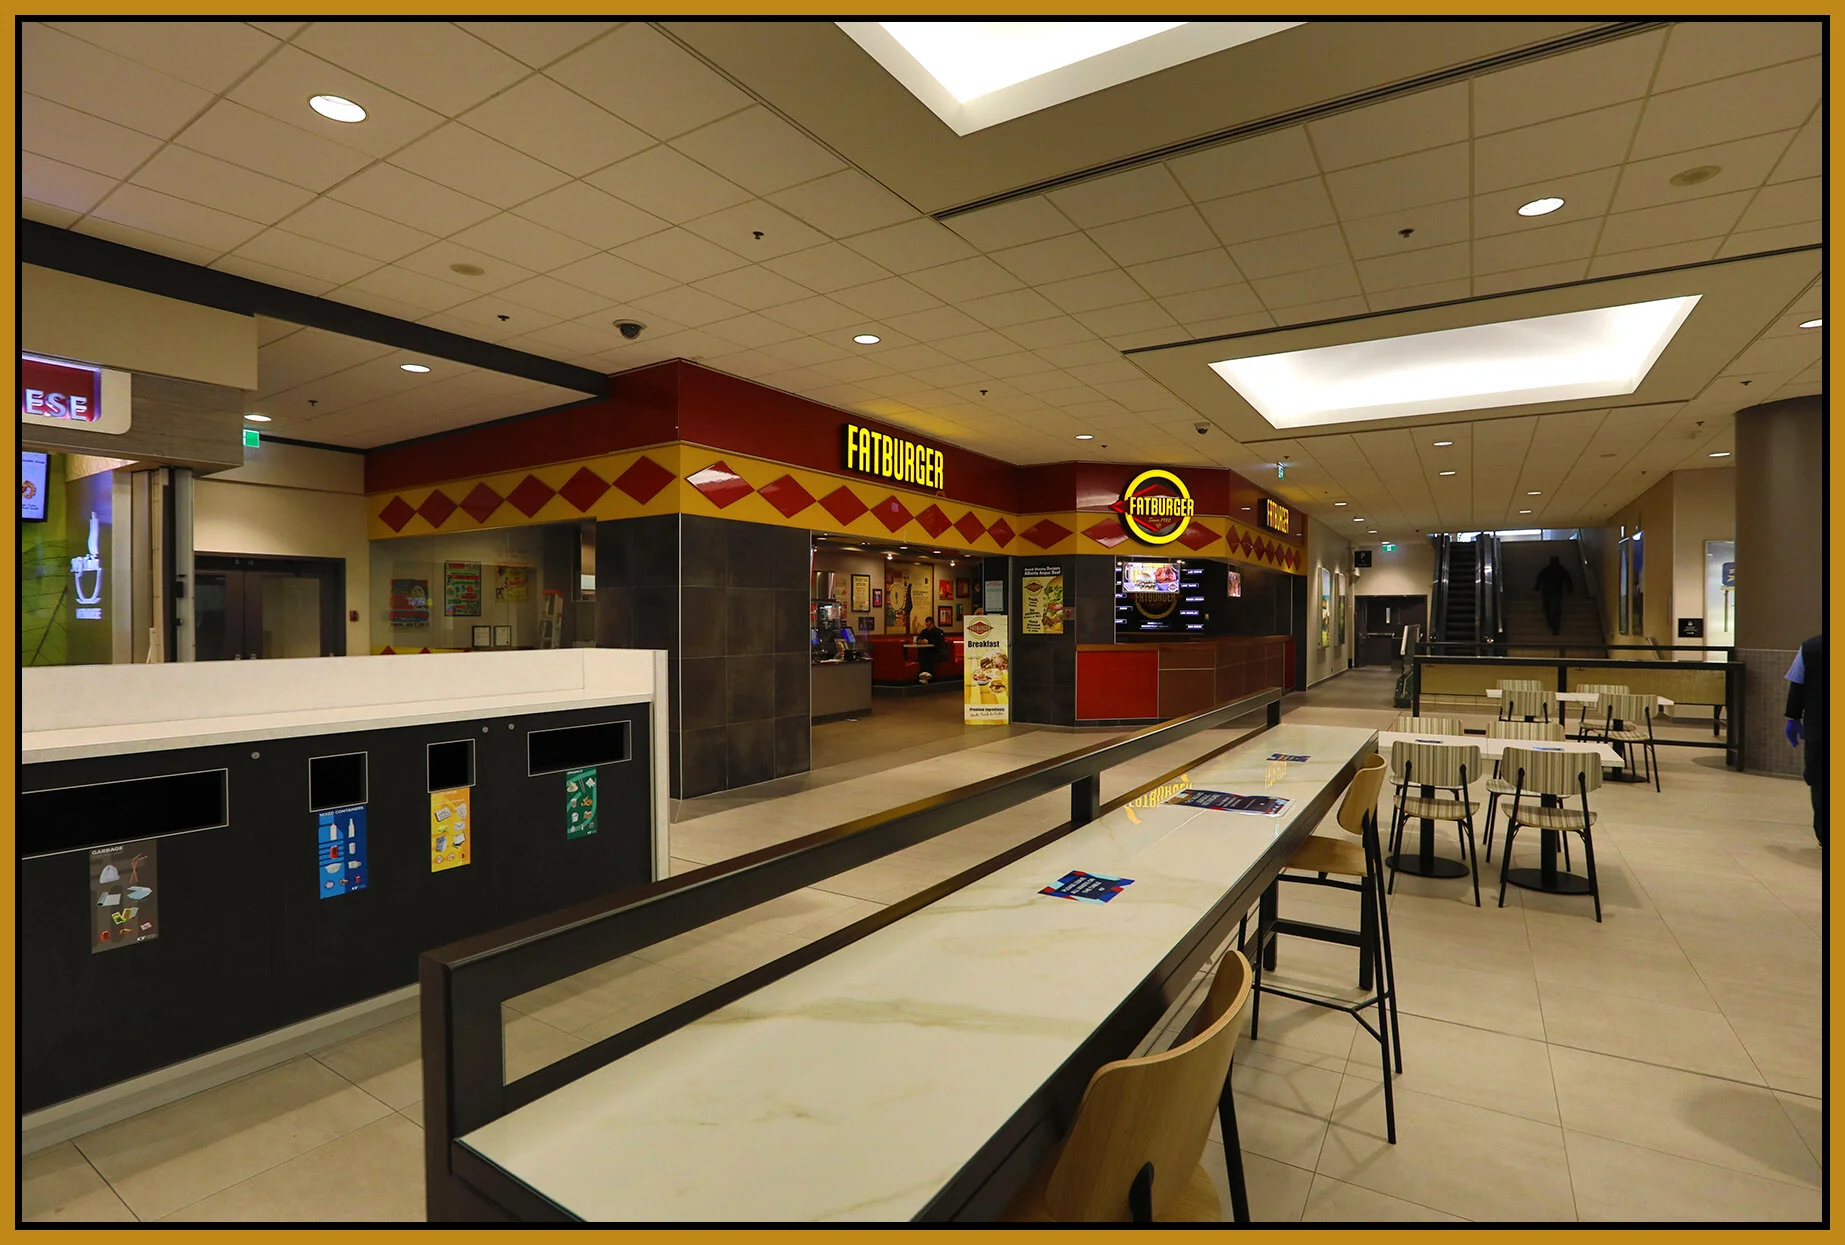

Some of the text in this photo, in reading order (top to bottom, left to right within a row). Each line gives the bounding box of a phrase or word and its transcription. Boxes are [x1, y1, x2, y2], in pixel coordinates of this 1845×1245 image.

[25, 388, 88, 421] ESE
[847, 424, 944, 489] FATBURGER
[1129, 496, 1195, 516] FATBURGER
[967, 640, 1000, 648] Breakfast
[335, 805, 364, 815] CONTAINERS
[92, 845, 124, 855] GARBAGE
